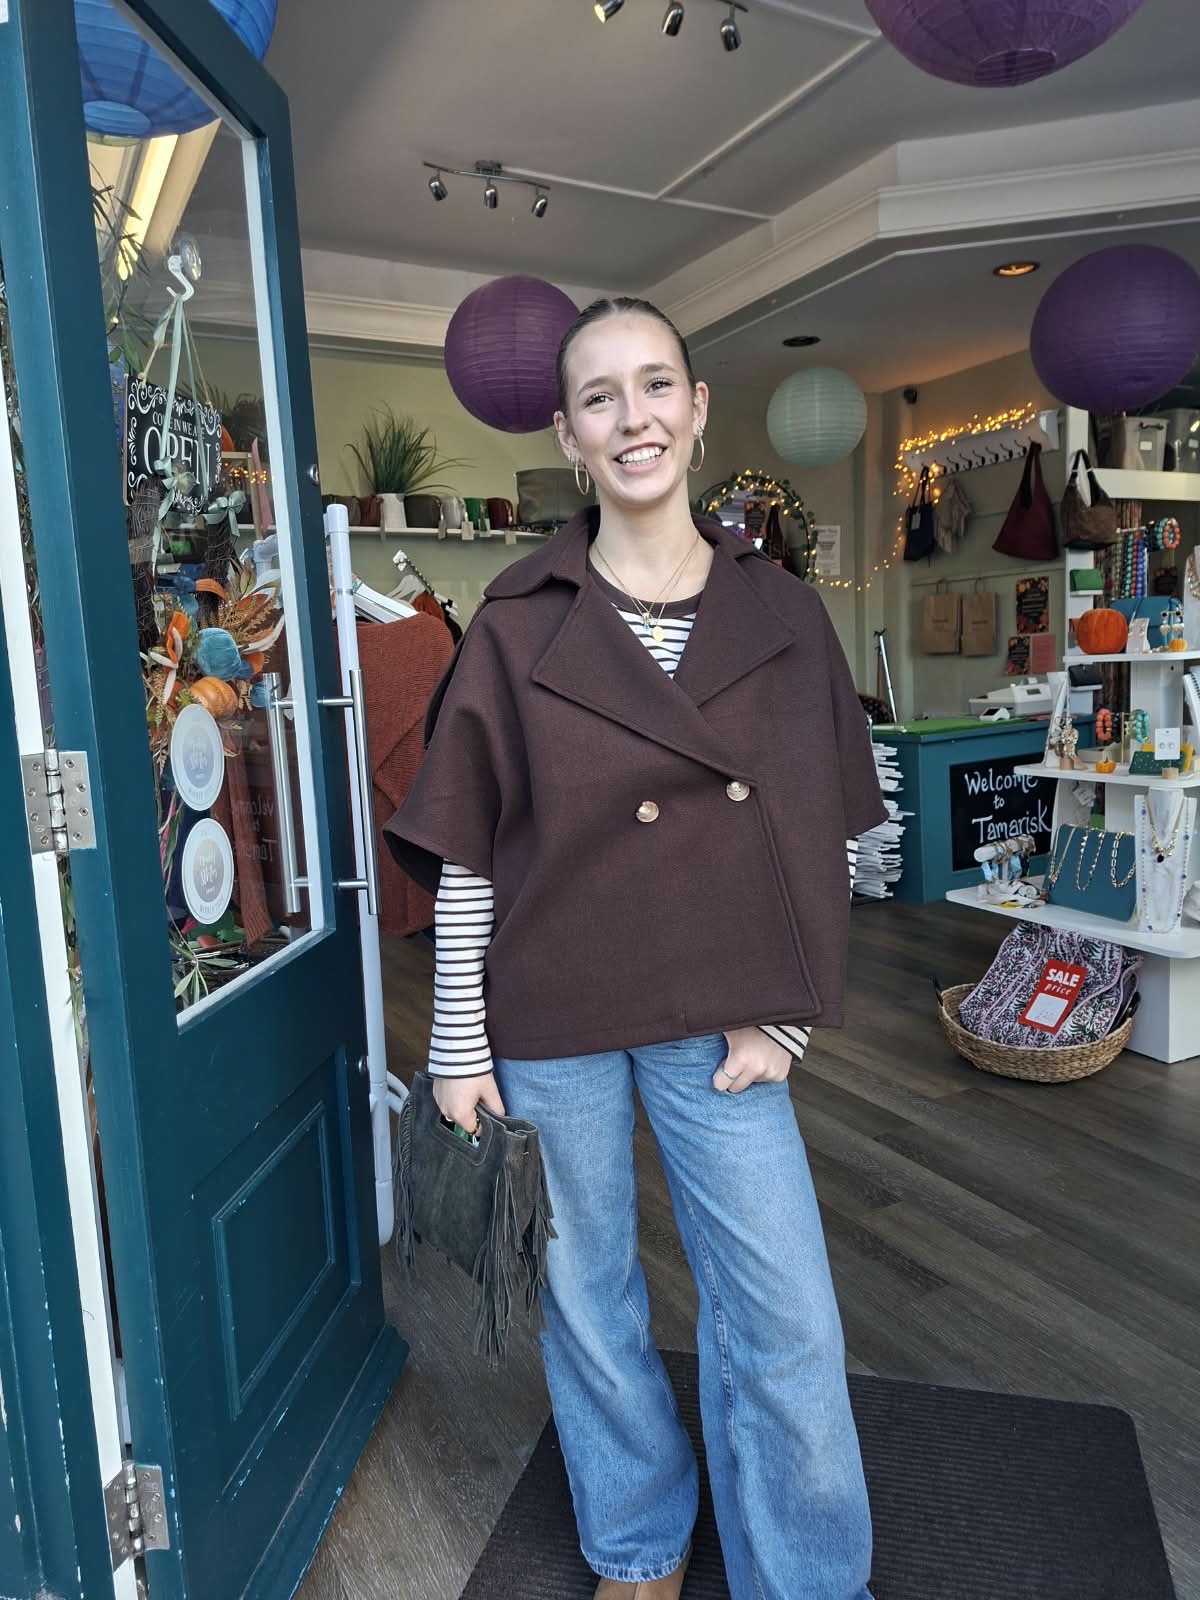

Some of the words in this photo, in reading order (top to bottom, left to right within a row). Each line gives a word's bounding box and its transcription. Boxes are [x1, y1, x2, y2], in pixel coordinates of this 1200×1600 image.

[152, 411, 173, 430] COE
[173, 418, 181, 431] IN
[182, 420, 192, 435] WE
[964, 768, 1039, 796] Welcome
[993, 794, 1005, 809] to
[971, 799, 1052, 843] Tamarisk
[1046, 968, 1081, 987] SALE
[1044, 983, 1072, 995] price
